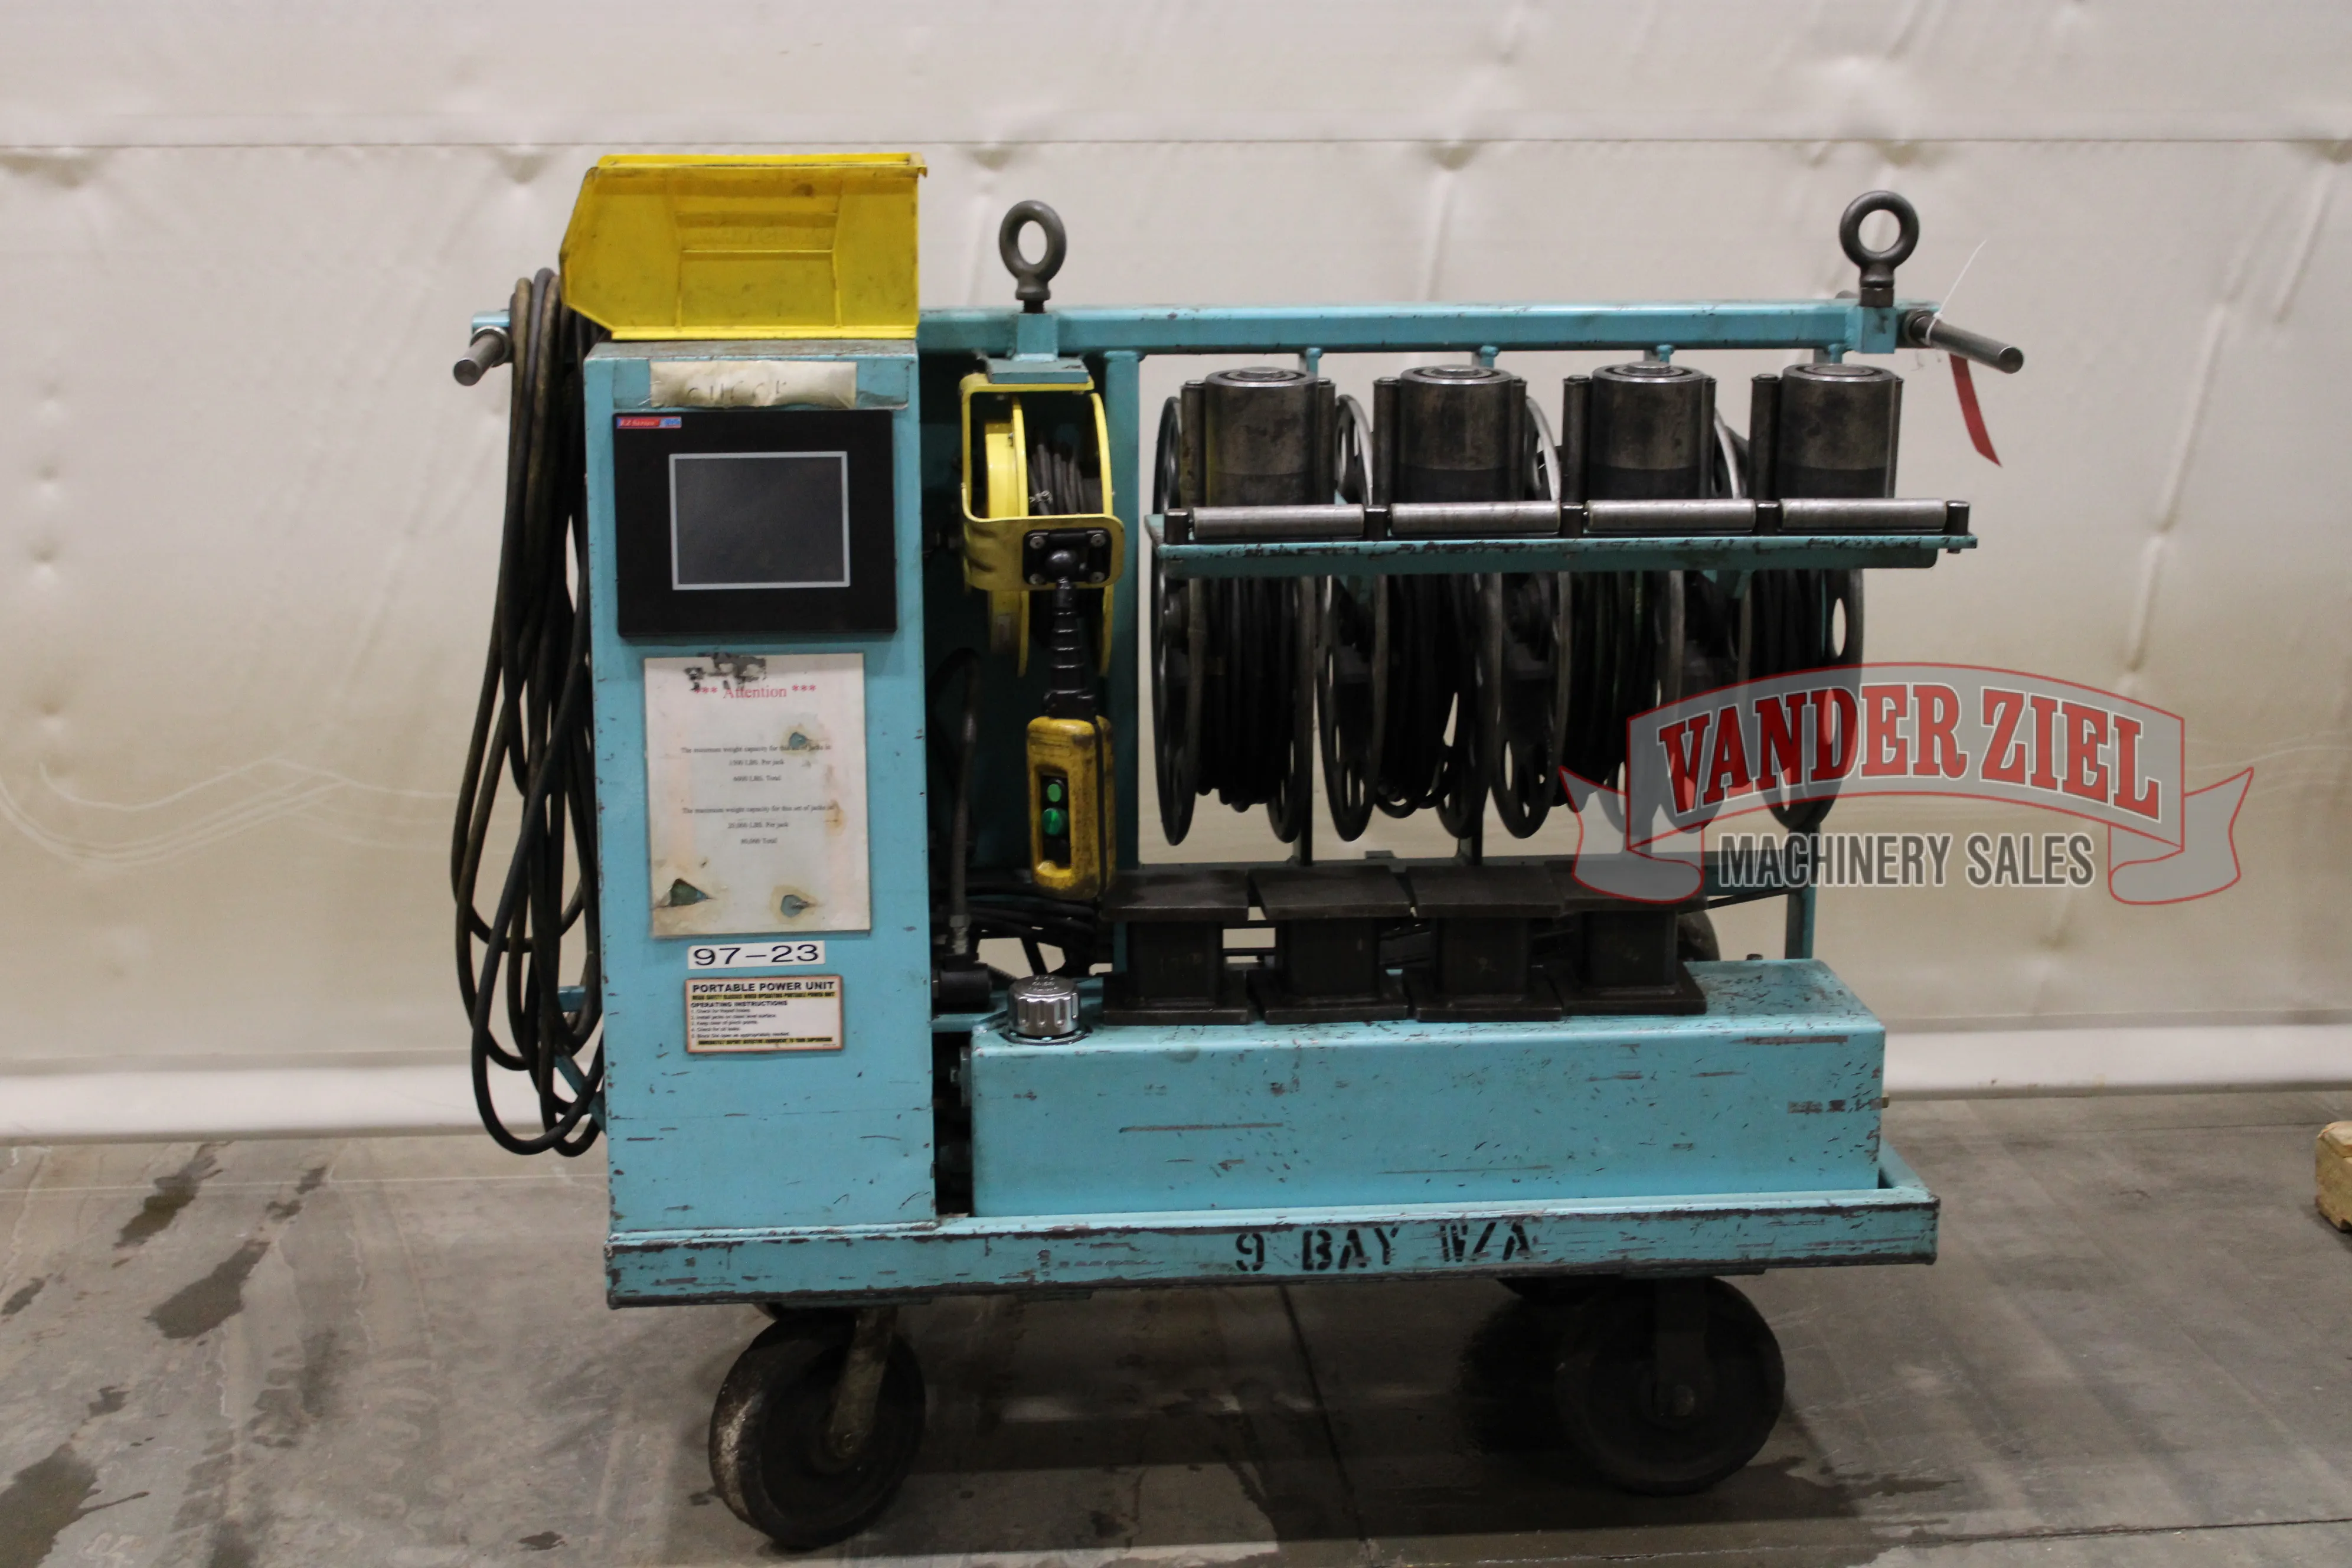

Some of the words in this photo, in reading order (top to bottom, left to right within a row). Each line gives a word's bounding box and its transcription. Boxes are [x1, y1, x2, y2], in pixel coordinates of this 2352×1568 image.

[723, 685, 787, 698] Attention
[693, 944, 819, 966] 97-23
[692, 982, 755, 992] PORTABLE
[759, 982, 802, 992] POWER
[805, 981, 835, 990] UNIT
[1236, 1232, 1265, 1271] 9
[1302, 1223, 1400, 1270] BAY
